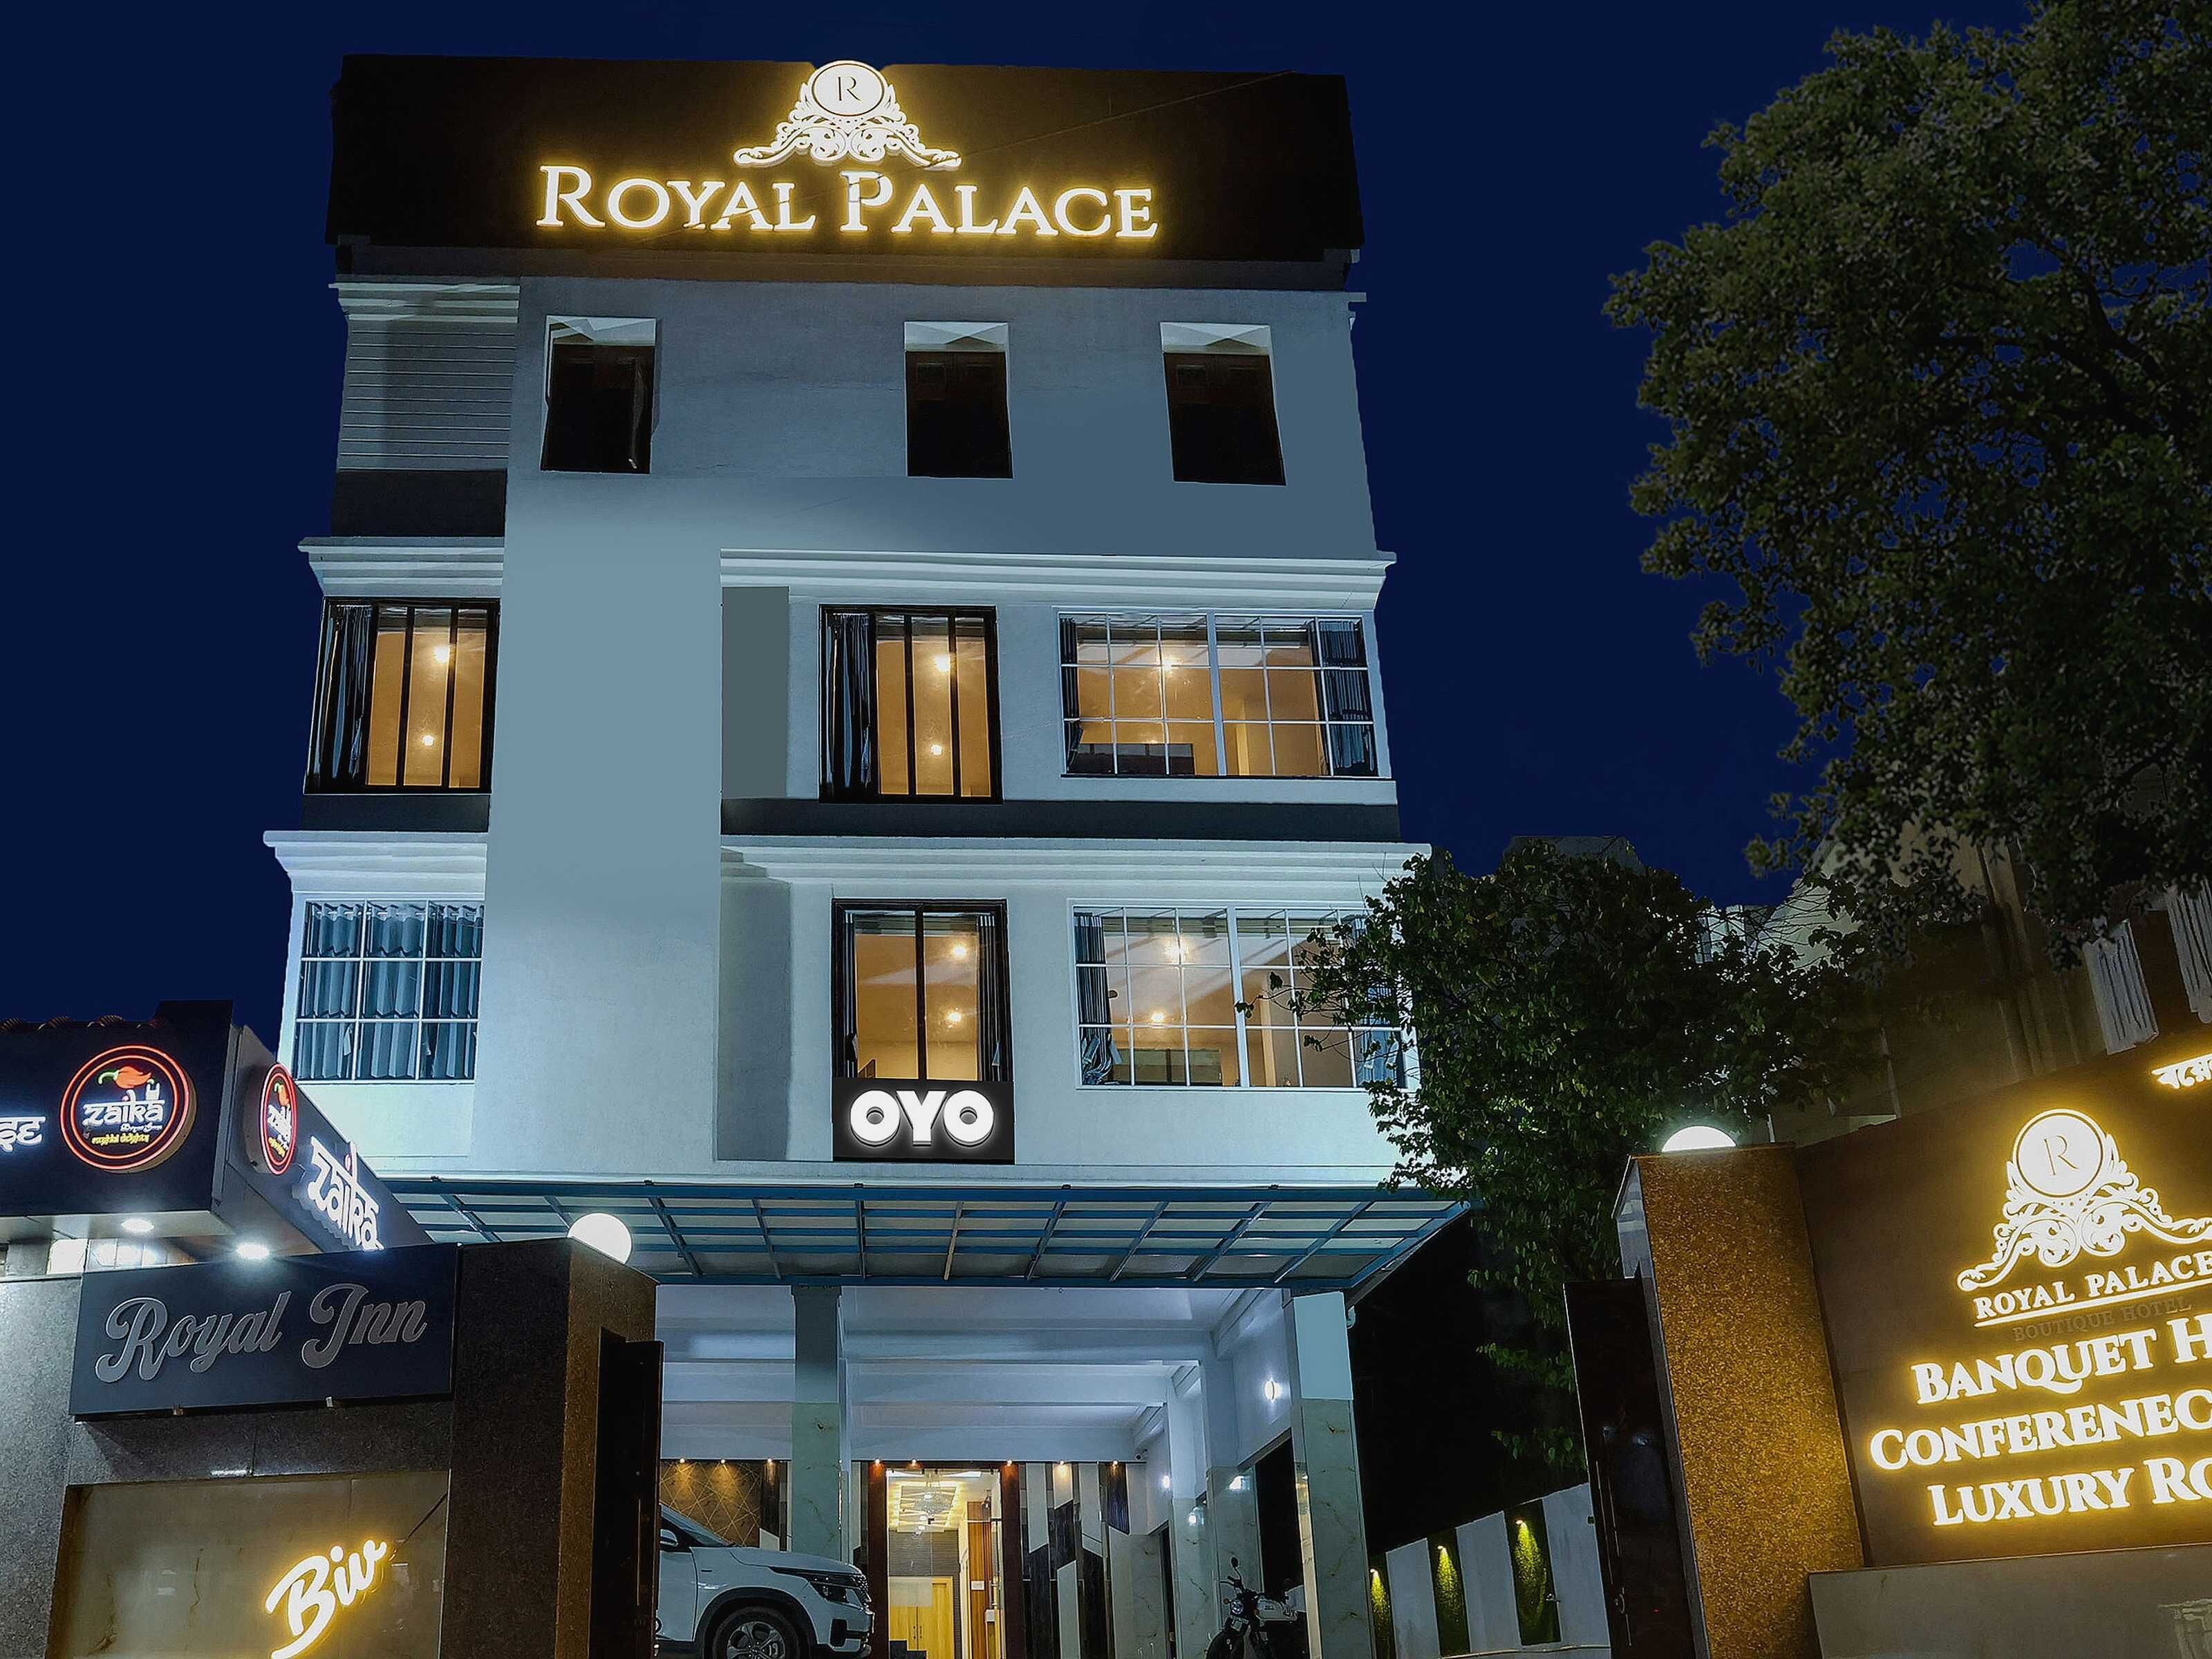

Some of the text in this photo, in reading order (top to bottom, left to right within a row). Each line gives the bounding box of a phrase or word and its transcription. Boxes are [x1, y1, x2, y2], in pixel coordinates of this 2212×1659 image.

[850, 1089, 994, 1147] OYO
[1974, 1250, 2212, 1320] ROYAL PALACE
[95, 1283, 428, 1383] Royal Inn
[2012, 1297, 2192, 1342] BOUTIQUE HOTEL
[1911, 1328, 2157, 1405] BANQUET
[1927, 1467, 2135, 1526] LUXURY
